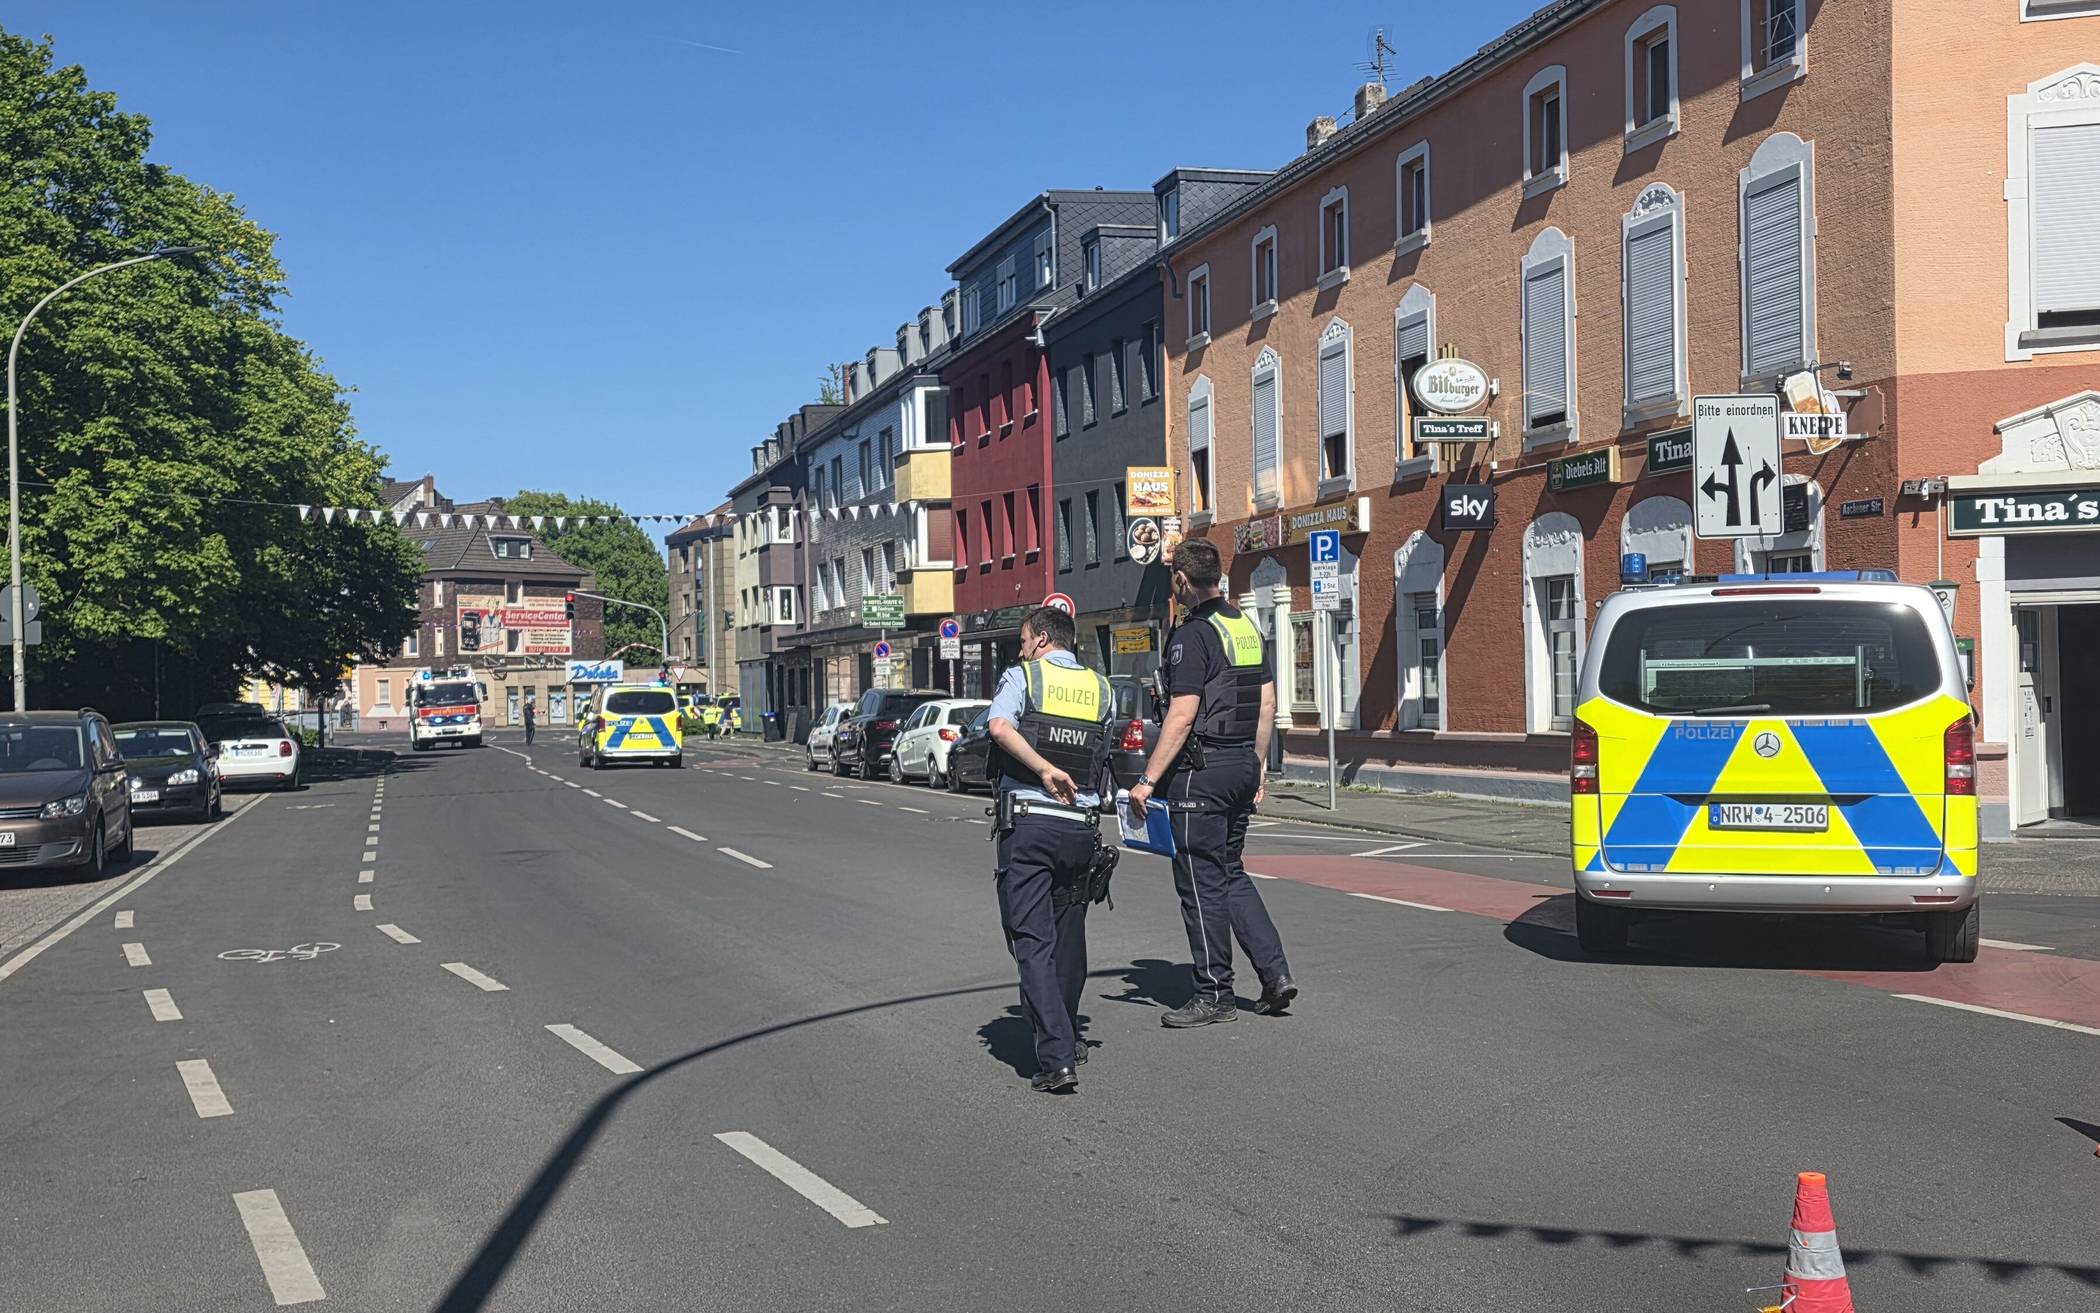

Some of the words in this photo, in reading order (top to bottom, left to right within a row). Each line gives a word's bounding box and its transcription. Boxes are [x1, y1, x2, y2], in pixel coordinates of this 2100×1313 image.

[1427, 374, 1480, 397] Bitburger
[1698, 404, 1720, 416] Bitte
[1726, 403, 1774, 416] einordnen
[1456, 424, 1483, 434] Treff
[1788, 416, 1843, 435] KNEIPE
[1565, 460, 1593, 479] Diebels
[1593, 457, 1607, 474] Alt
[1133, 482, 1169, 492] HAUS
[1327, 506, 1347, 523] HAUS
[1450, 494, 1489, 521] sky
[1316, 535, 1332, 561] P
[1235, 635, 1259, 650] POLIZEI
[1048, 684, 1095, 706] POLIZEI
[1049, 726, 1088, 746] NRW
[1675, 727, 1735, 740] POLIZEI
[1721, 806, 1753, 823] NRW
[1764, 806, 1826, 824] 4-2506
